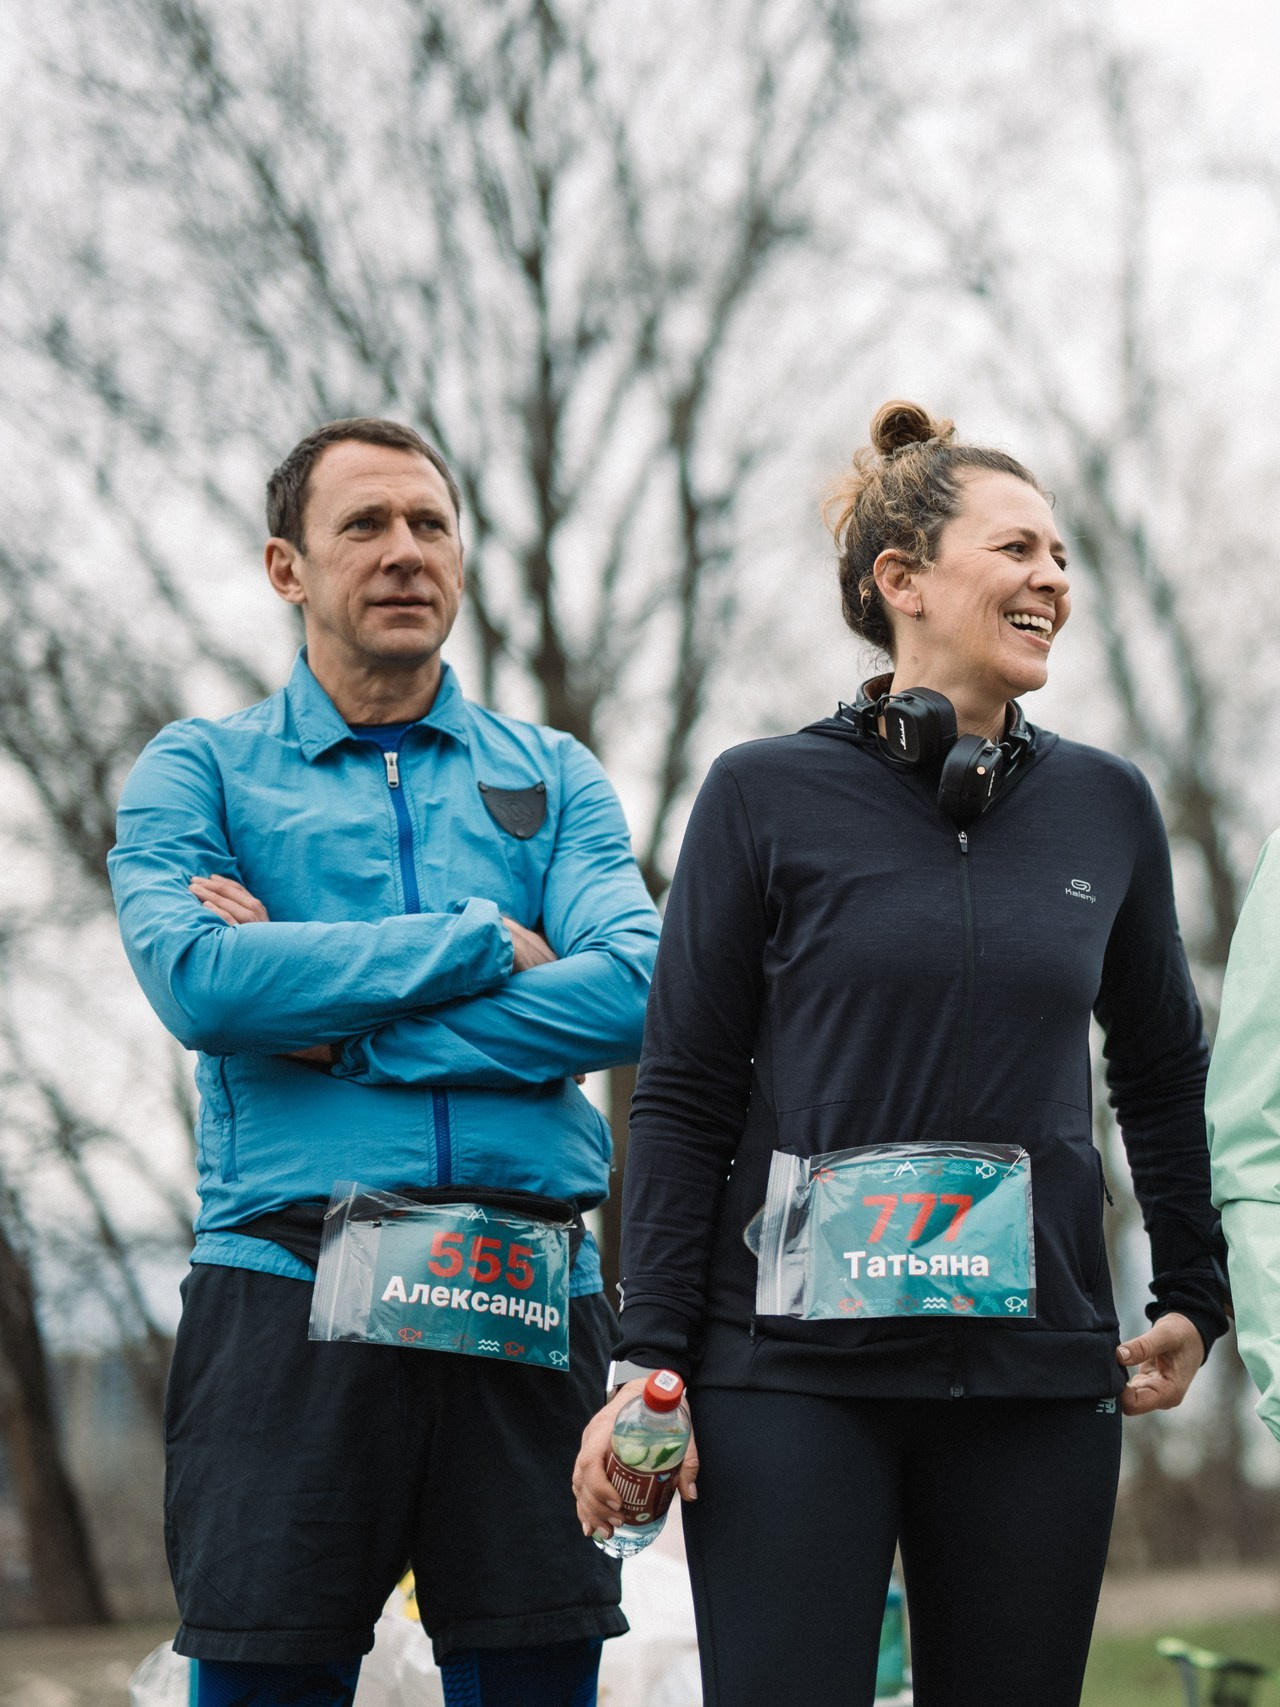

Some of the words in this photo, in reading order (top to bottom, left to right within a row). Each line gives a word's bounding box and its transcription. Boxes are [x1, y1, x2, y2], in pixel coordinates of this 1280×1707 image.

[863, 1193, 973, 1244] 777
[427, 1231, 535, 1290] 555
[843, 1251, 990, 1279] Татьяна
[381, 1275, 560, 1331] Александр
